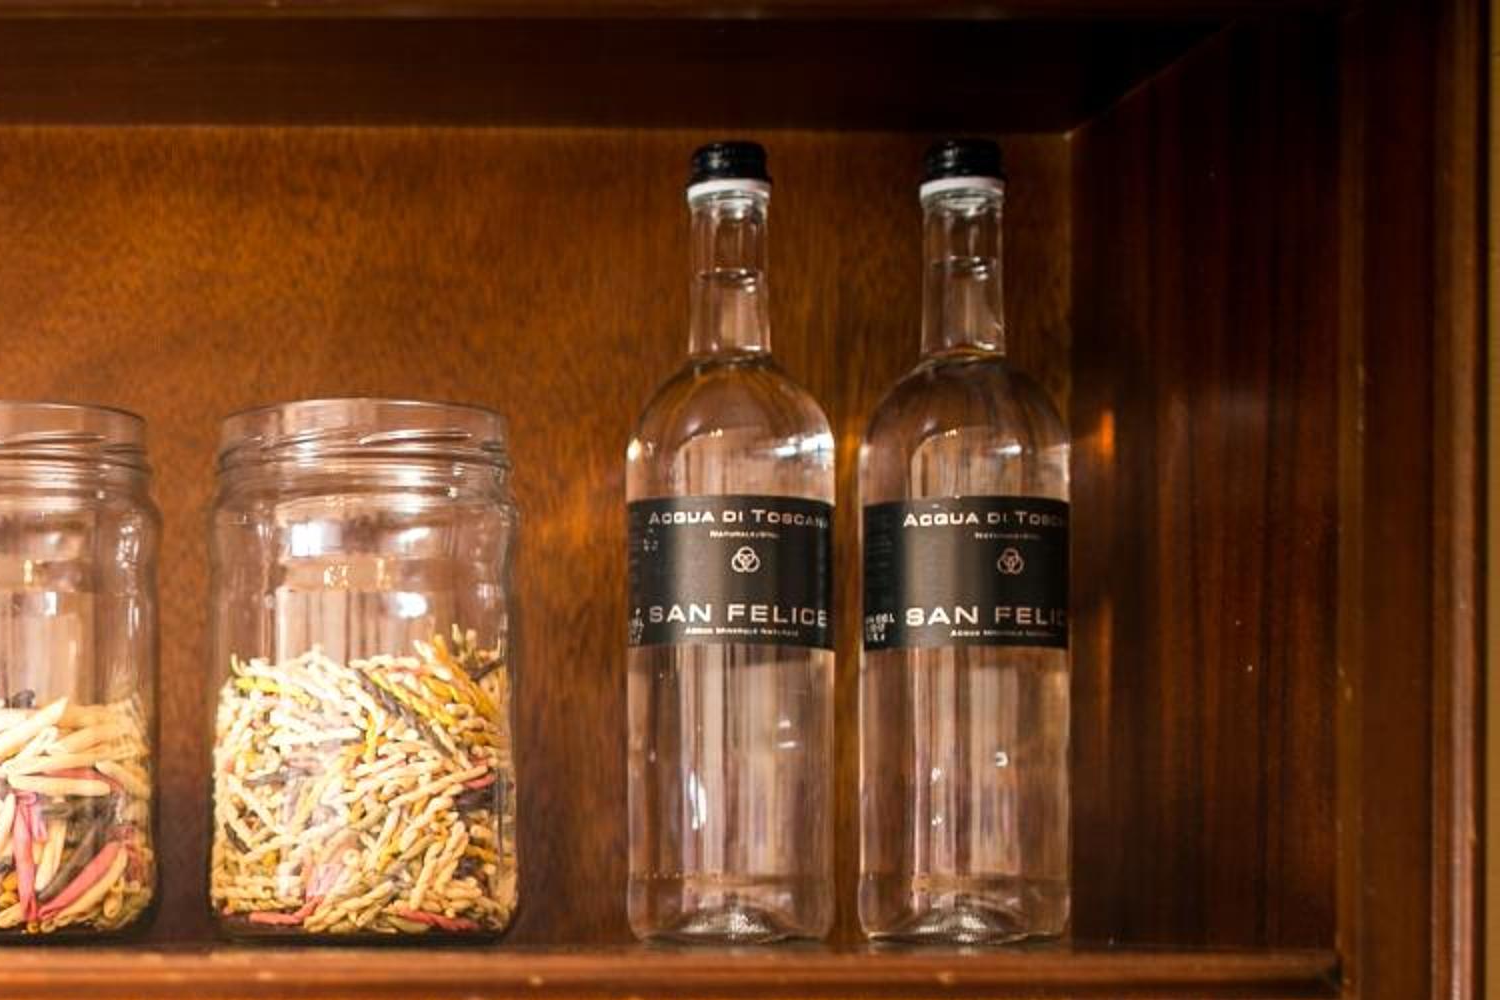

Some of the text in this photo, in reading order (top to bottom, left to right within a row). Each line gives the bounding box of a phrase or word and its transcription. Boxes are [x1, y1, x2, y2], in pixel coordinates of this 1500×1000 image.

[648, 510, 715, 526] ACQUA
[722, 510, 744, 524] DI
[903, 511, 980, 528] ACQUA
[987, 511, 1007, 524] DI
[649, 603, 828, 628] SAN FELICE
[905, 605, 980, 627] SAN
